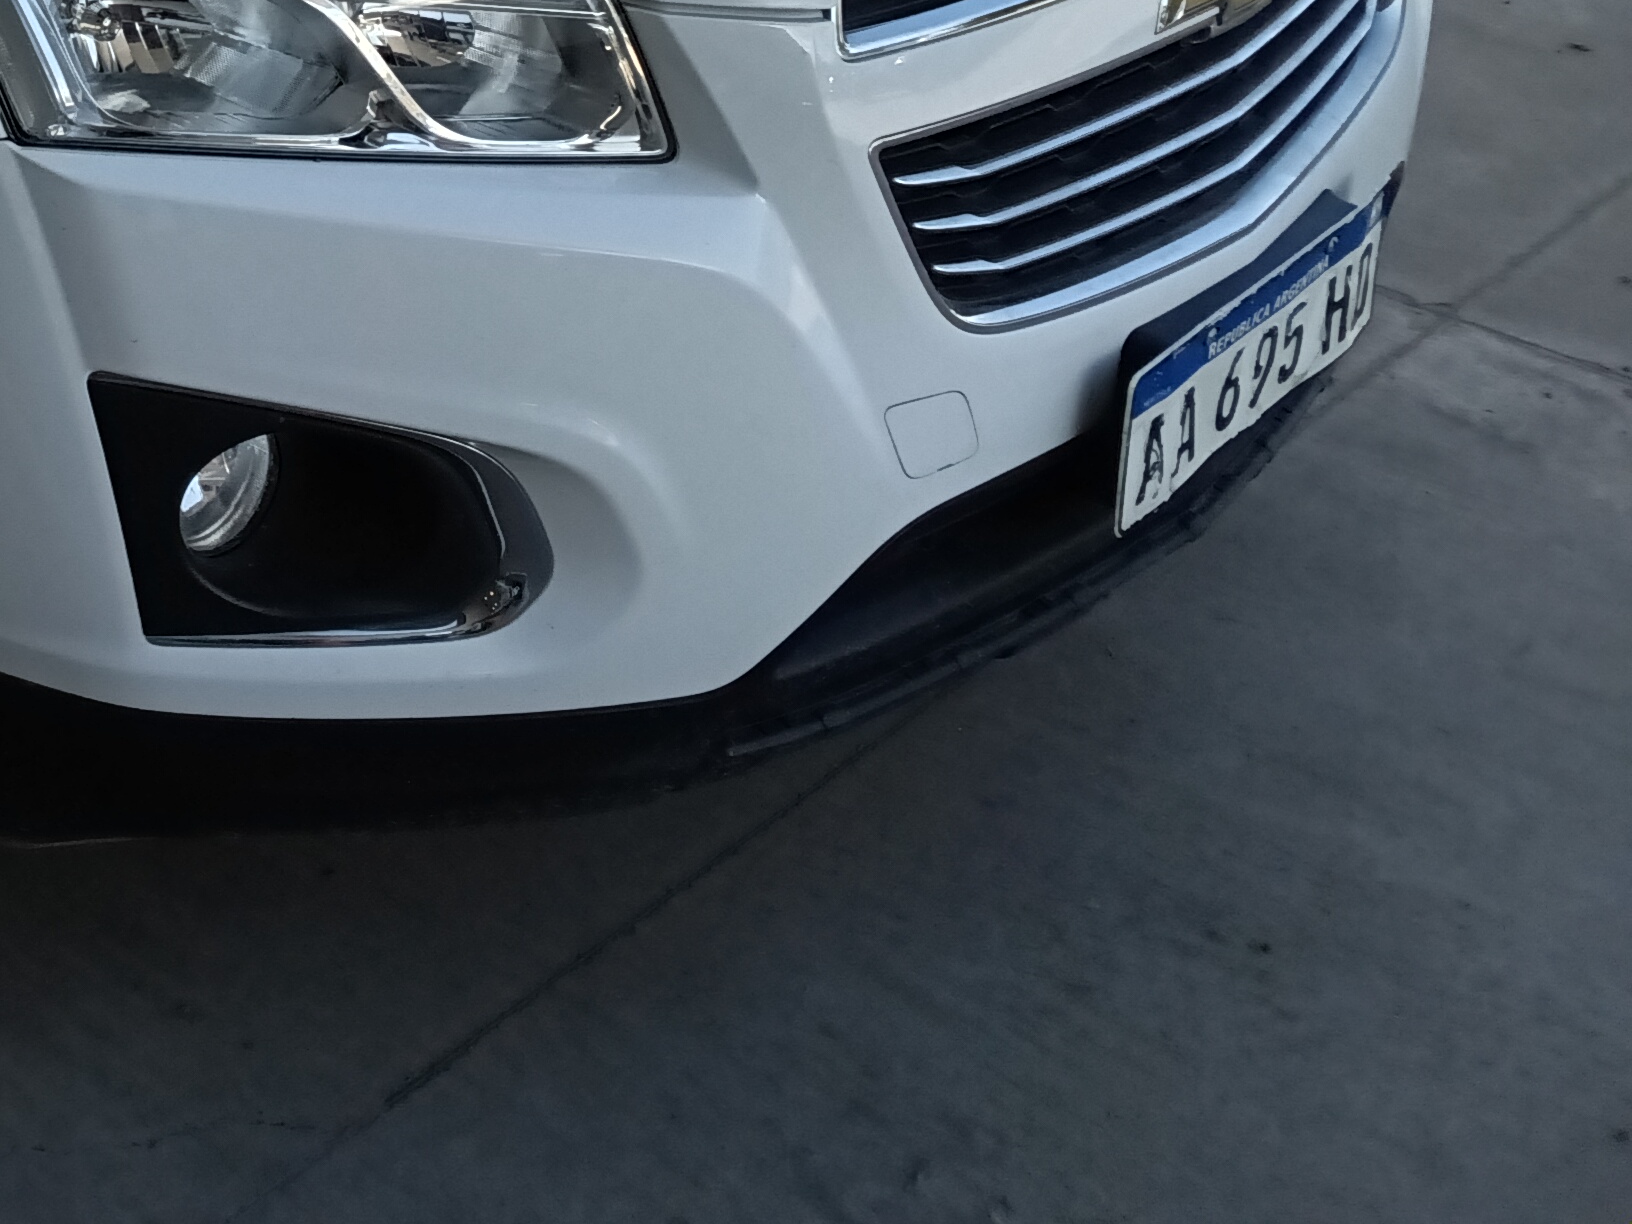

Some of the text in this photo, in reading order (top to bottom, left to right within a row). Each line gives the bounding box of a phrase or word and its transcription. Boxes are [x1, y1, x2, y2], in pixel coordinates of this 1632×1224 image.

[1135, 242, 1373, 506] AA 695 HD
